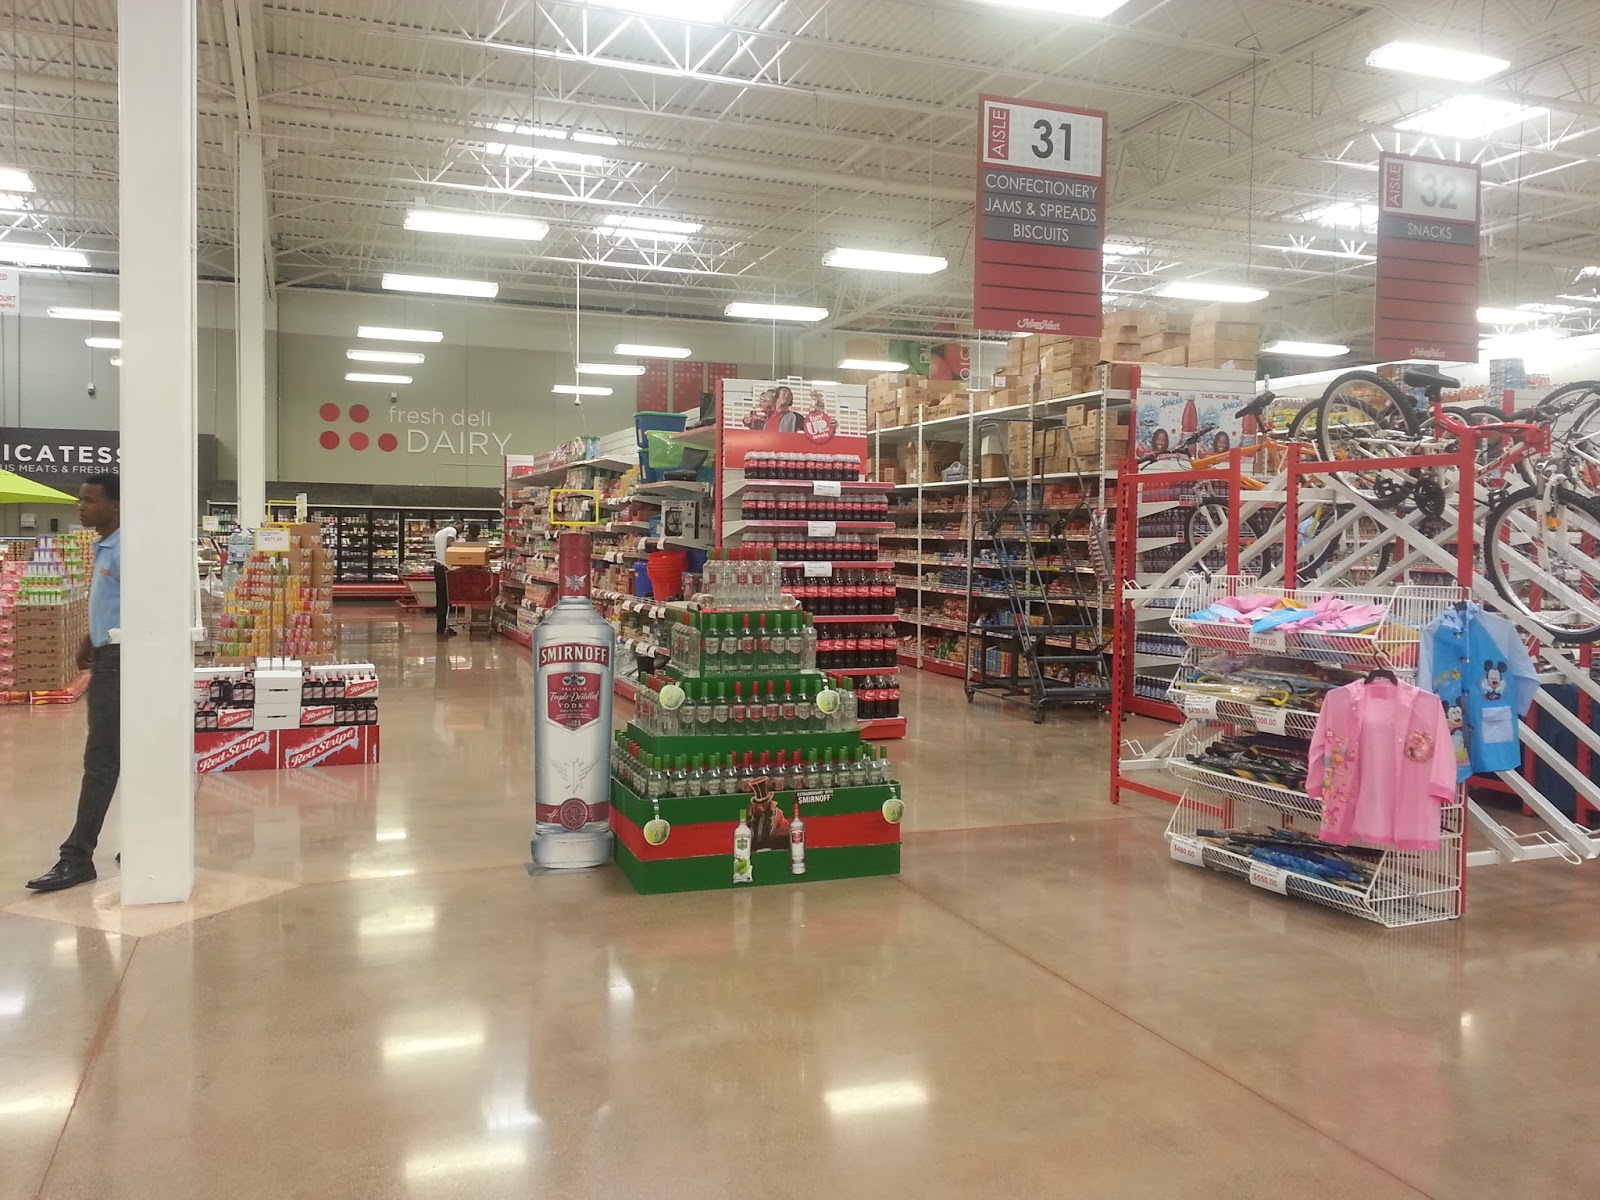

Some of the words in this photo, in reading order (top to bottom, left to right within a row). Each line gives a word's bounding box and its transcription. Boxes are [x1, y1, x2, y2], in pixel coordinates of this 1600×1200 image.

[992, 109, 1006, 157] AISLE
[1031, 119, 1072, 161] 31
[985, 173, 1098, 199] CONFECTIONERY
[1389, 164, 1400, 206] AISLE
[1421, 173, 1457, 210] 32
[985, 198, 1022, 214] JAMS
[1026, 202, 1036, 216] &
[1039, 203, 1097, 222] SPREADS
[1013, 223, 1069, 242] BISCUITS
[1407, 222, 1452, 239] SNACKS
[389, 406, 444, 424] fresh
[451, 409, 491, 427] deli
[407, 429, 513, 456] DAIRY
[19, 464, 58, 473] MEATS
[61, 466, 69, 474] &
[72, 466, 109, 474] FRESH
[541, 646, 607, 663] SMIRNOFF
[199, 753, 227, 772] Red
[226, 732, 266, 759] Stripe
[290, 751, 316, 768] Red
[315, 728, 355, 756] Stripe
[798, 795, 831, 805] SMIRNOFF
[1253, 873, 1278, 887] $550.00
